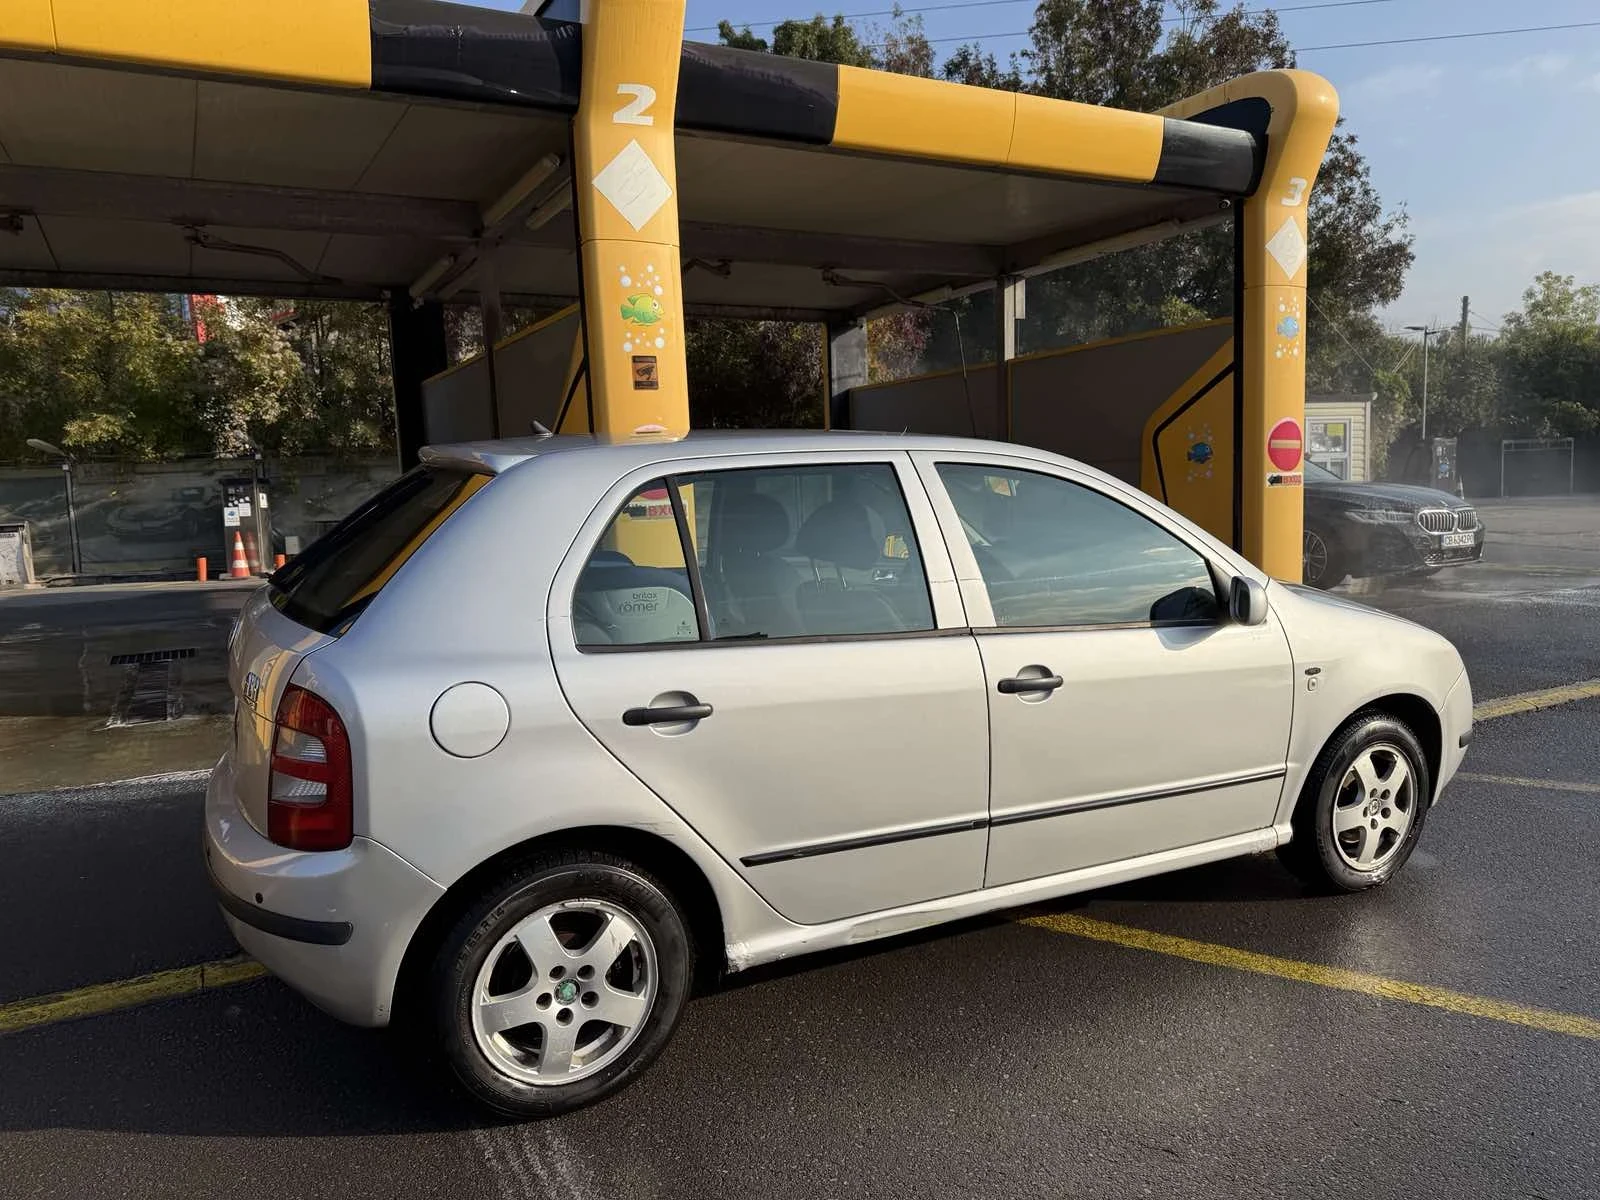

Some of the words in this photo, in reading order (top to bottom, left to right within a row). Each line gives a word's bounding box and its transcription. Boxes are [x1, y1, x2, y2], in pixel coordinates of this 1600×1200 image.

[613, 83, 656, 126] 2
[1281, 177, 1307, 206] 3
[632, 592, 657, 600] britax
[619, 601, 659, 612] römer
